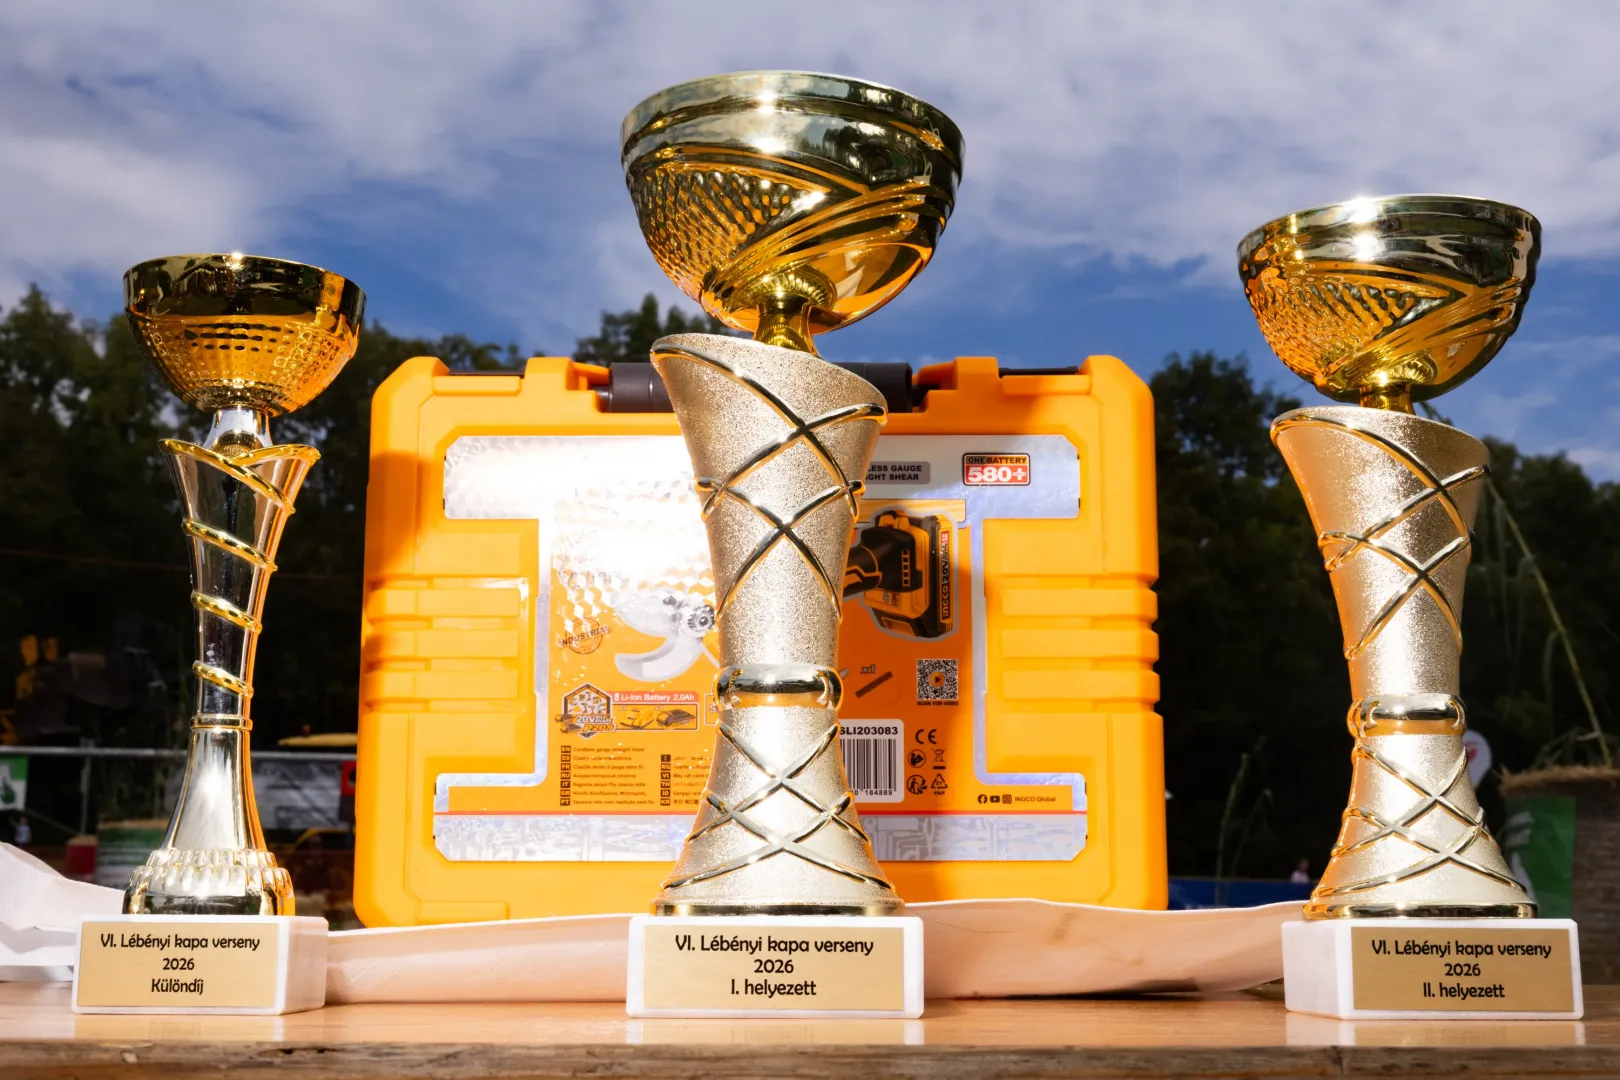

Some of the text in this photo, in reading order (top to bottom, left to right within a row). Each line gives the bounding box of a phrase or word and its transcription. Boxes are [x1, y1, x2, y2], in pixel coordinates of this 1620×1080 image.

[986, 457, 1027, 465] BATTERY
[968, 467, 1027, 482] 580+
[621, 693, 694, 702] Li-Ion Battery 2.0Ah
[576, 715, 595, 723] 20V
[840, 726, 898, 735] SLI203083
[101, 934, 260, 952] VI. Lébényi kapa verseny
[675, 935, 874, 956] VI. Lébényi kapa verseny
[1371, 940, 1552, 959] VI. Lébényi kapa verseny
[163, 958, 195, 971] 2026
[753, 959, 794, 974] 2026
[1444, 963, 1481, 977] 2026
[151, 978, 204, 995] Különdíj
[731, 979, 817, 998] I. helyezett
[1423, 983, 1505, 1000] II. helyezett
